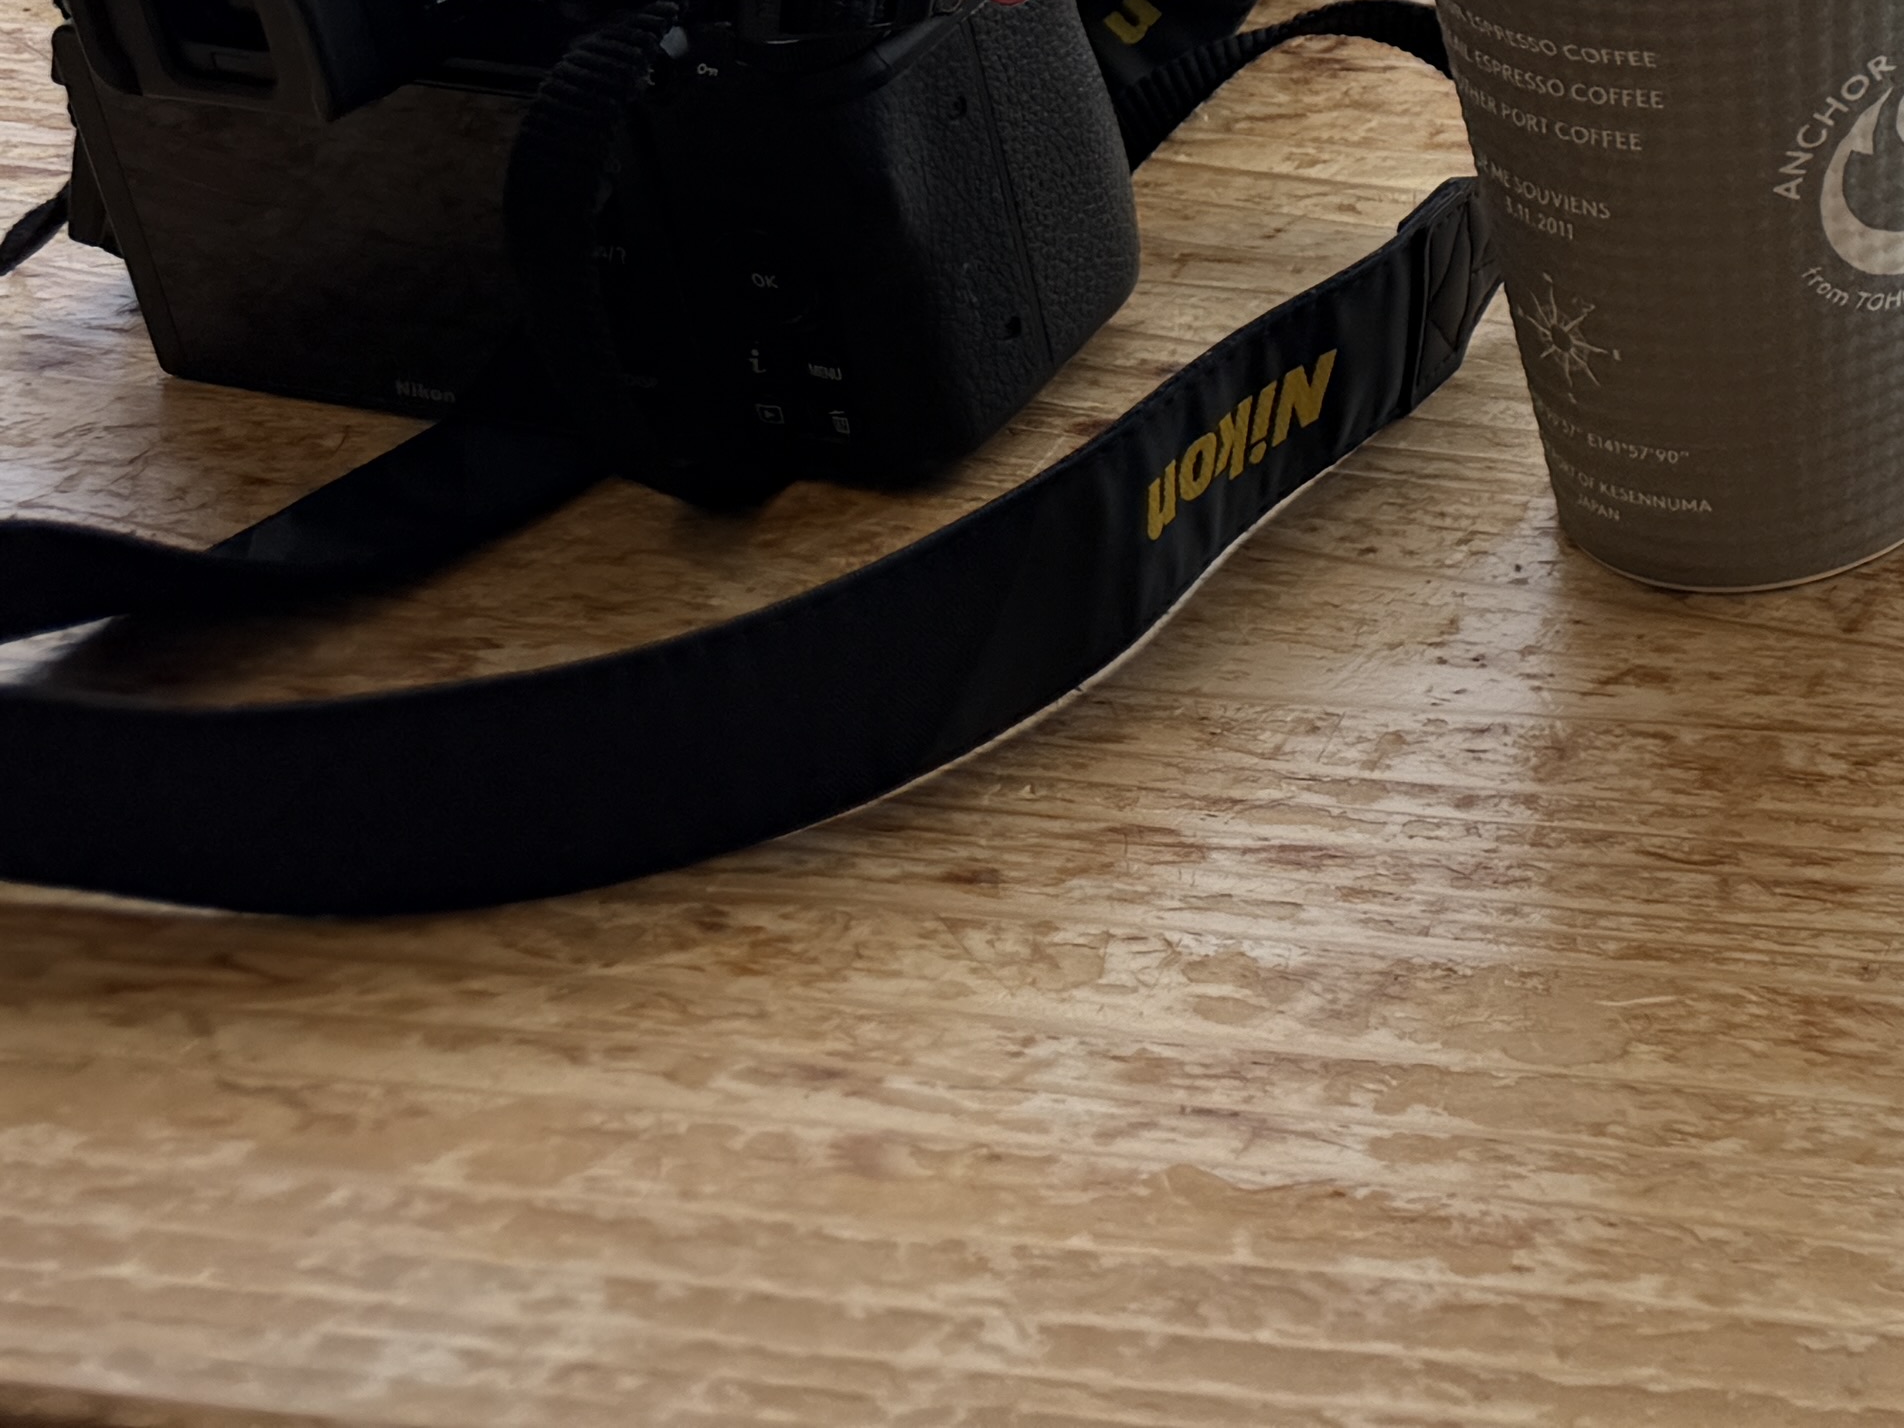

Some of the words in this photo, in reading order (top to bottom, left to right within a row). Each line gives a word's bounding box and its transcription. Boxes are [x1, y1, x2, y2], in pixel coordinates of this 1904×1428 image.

[1562, 43, 1659, 69] COFFEE
[1571, 82, 1665, 109] COFFEE
[1501, 107, 1548, 134] PORT
[1554, 121, 1644, 152] COFFEE
[1773, 54, 1898, 200] ANCHOR
[751, 272, 779, 289] OK
[1801, 265, 1848, 307] from
[394, 377, 456, 404] Nikon
[1145, 347, 1337, 541] Nikon
